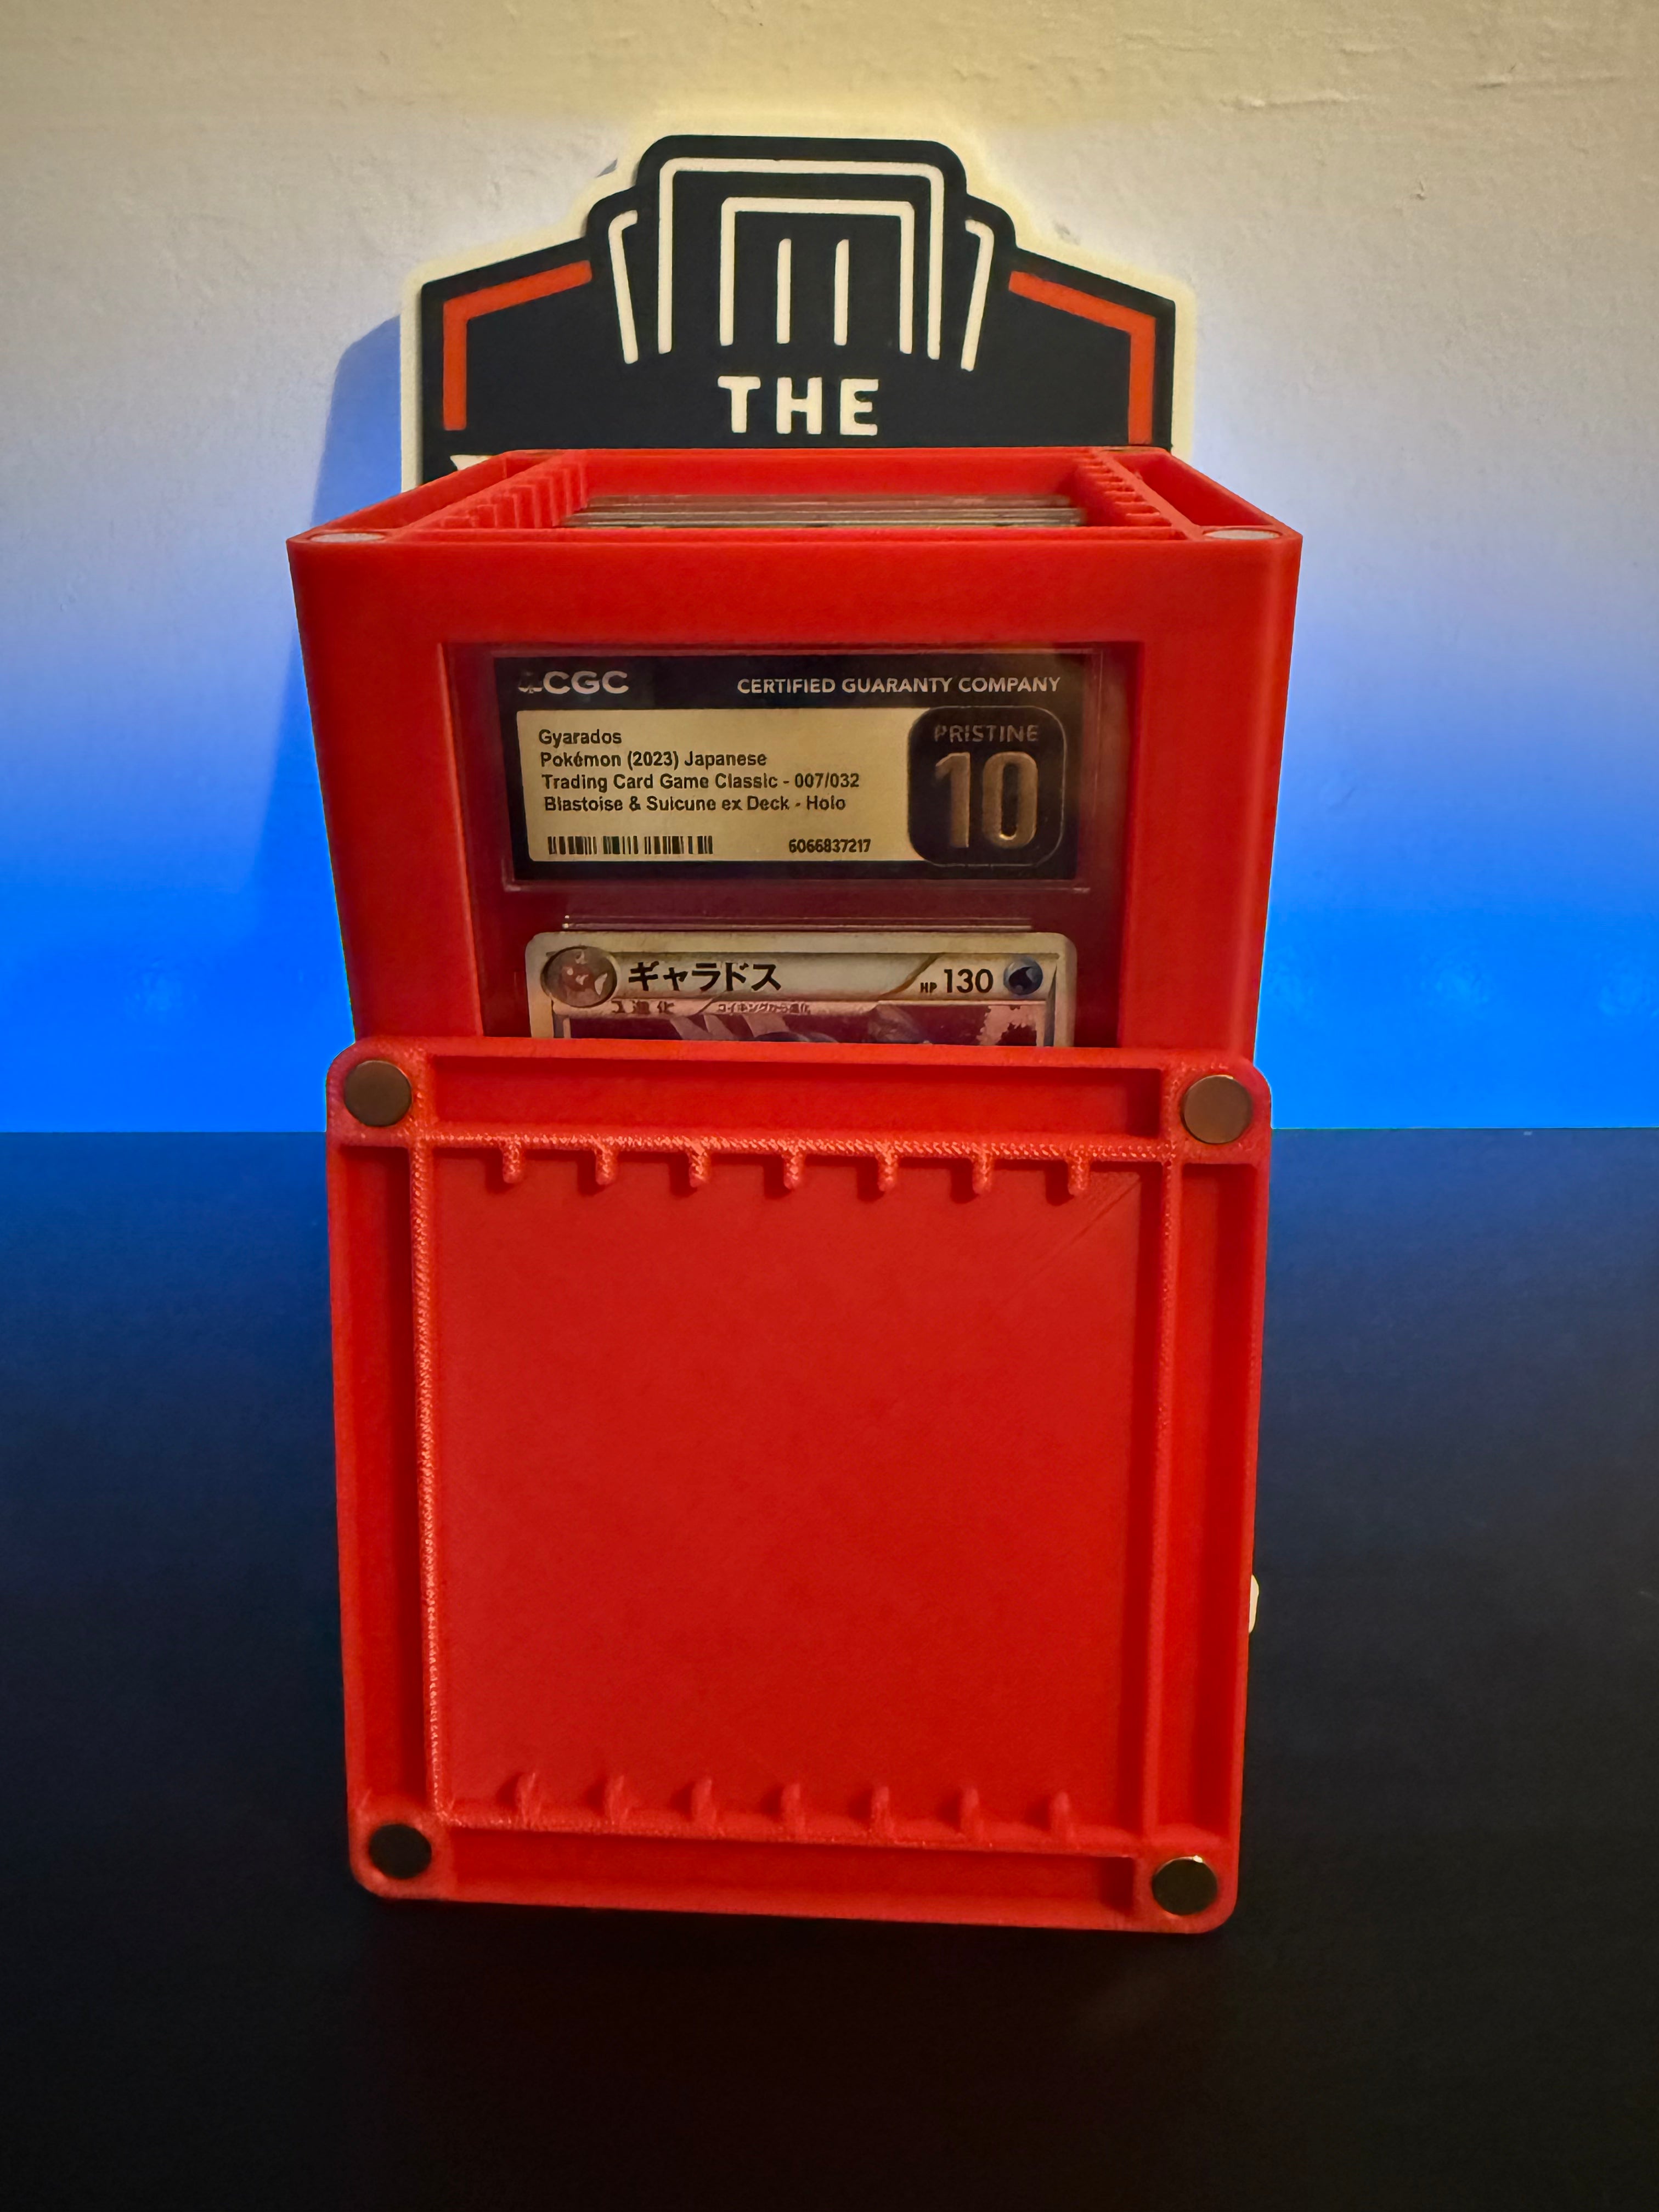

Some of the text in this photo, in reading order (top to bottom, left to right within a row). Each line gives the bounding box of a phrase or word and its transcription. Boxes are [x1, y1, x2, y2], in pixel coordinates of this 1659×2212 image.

[718, 376, 879, 436] THE
[543, 670, 629, 694] CGC
[737, 676, 1061, 694] CERTIFIED GUARANTY COMPANY
[539, 729, 622, 748] Gyarados
[934, 724, 1039, 743] PRISTINE
[540, 751, 767, 770] Pokémon (2023) Japanese
[541, 774, 607, 793] Trading
[613, 774, 653, 789] Card
[659, 773, 709, 789] Game
[715, 772, 778, 788] Classic
[794, 772, 860, 788] 007/032
[544, 796, 623, 811] Blastoise
[629, 795, 641, 811] &
[646, 795, 716, 811] Suicune
[721, 799, 743, 811] ex
[747, 795, 789, 810] Deck
[806, 795, 846, 810] Holo
[934, 751, 1039, 848] 10
[788, 838, 871, 853] 6066837217
[629, 961, 781, 991] ギャラドス
[920, 968, 994, 994] HP 130
